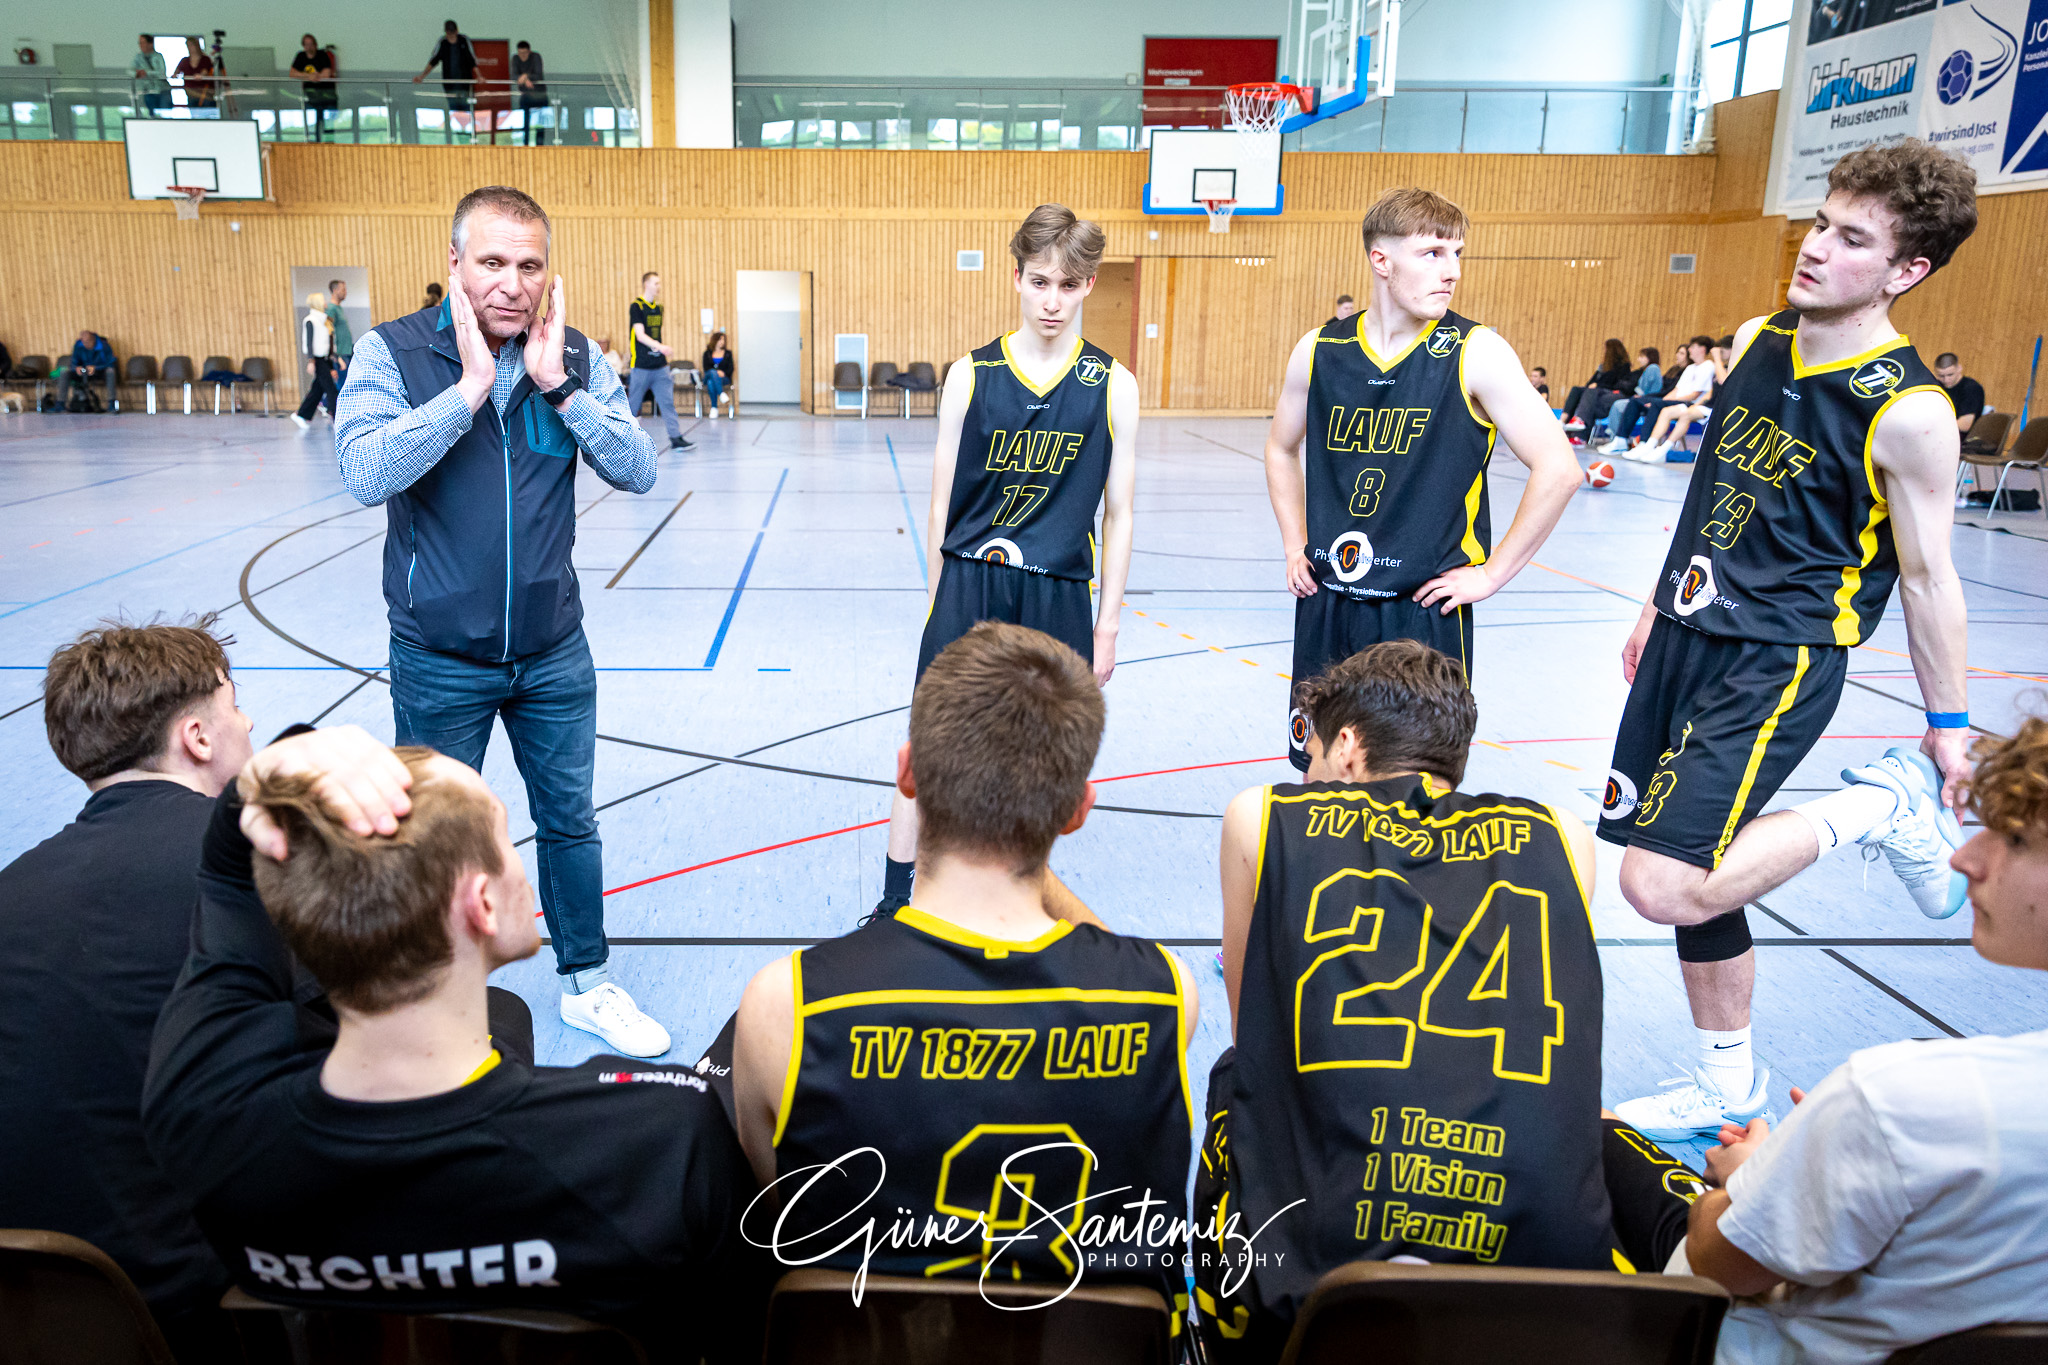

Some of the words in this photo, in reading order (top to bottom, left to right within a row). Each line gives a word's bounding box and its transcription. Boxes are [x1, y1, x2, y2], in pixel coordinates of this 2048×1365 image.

[1805, 53, 1917, 115] birkmann
[1830, 100, 1909, 129] Haustechnik
[1928, 120, 1998, 142] #wirsindJost
[985, 429, 1084, 475] LAUF
[1327, 405, 1432, 454] LAUF
[1715, 405, 1818, 489] LAUF
[992, 484, 1050, 528] 17
[1349, 468, 1386, 517] 8
[1306, 805, 1359, 838] TV
[1442, 818, 1531, 862] LAUF
[1295, 868, 1564, 1084] 24
[850, 1026, 913, 1079] TV
[921, 1028, 1036, 1080] 1877
[1043, 1022, 1150, 1080] LAUF
[1370, 1107, 1388, 1144] 1
[1401, 1107, 1506, 1157] Team
[1363, 1152, 1381, 1191] 1
[1391, 1152, 1506, 1206] Vision
[1355, 1200, 1373, 1240] 1
[1381, 1201, 1508, 1263] Family
[245, 1239, 560, 1291] RICHTER
